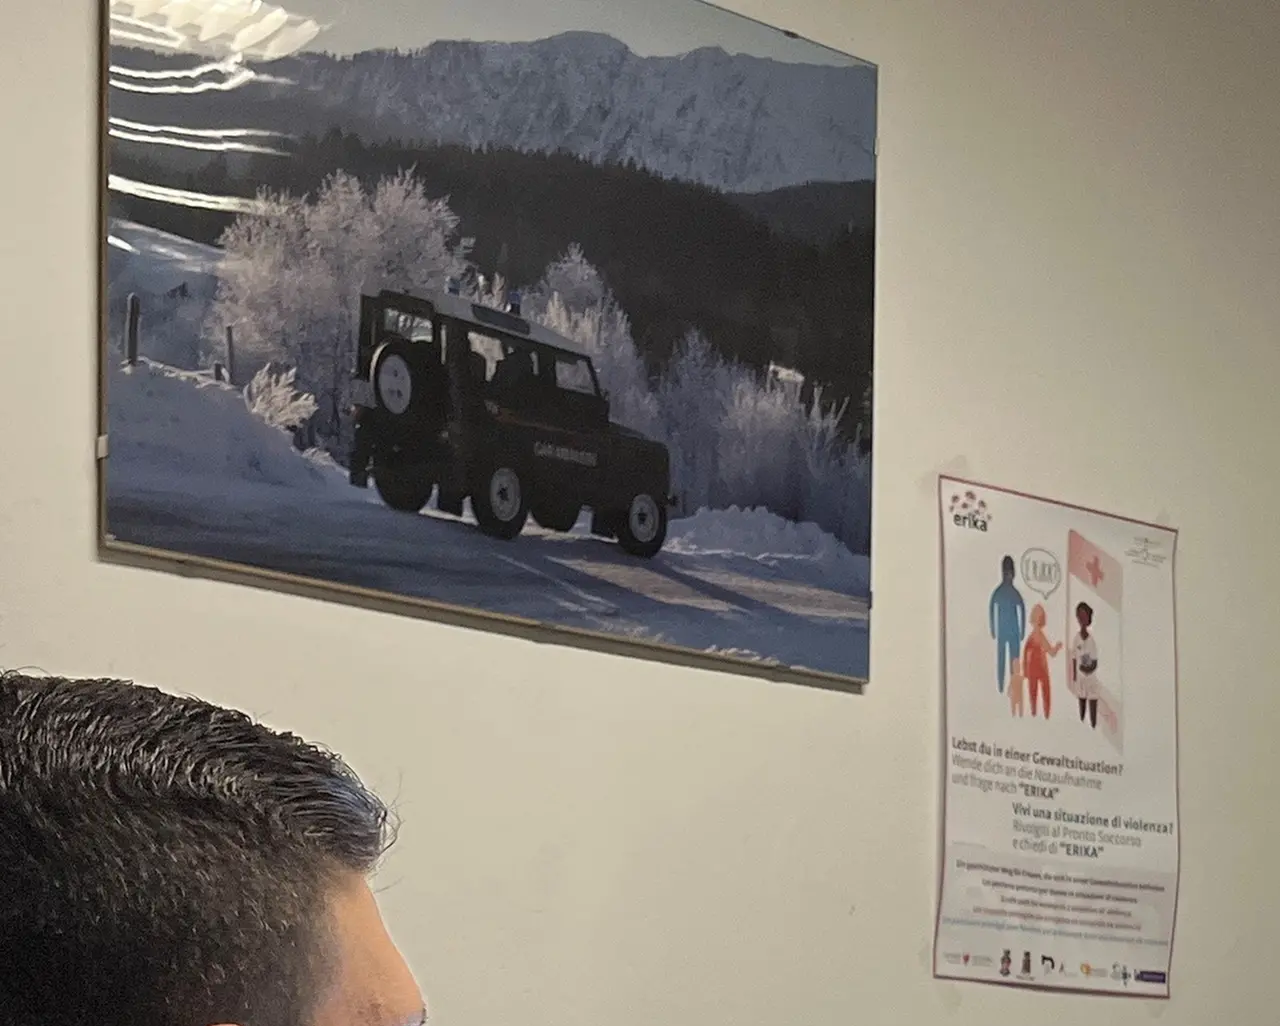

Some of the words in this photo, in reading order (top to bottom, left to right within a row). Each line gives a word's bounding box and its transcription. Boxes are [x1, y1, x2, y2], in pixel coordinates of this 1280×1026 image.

[953, 512, 988, 532] erika
[952, 736, 977, 752] Lebst
[979, 742, 991, 756] du
[993, 743, 1003, 757] in
[1005, 746, 1030, 762] einer
[1032, 752, 1124, 776] Gewaltsituation?
[1012, 802, 1031, 816] Vivi
[1033, 807, 1051, 820] una
[1054, 808, 1109, 828] situazione
[1111, 816, 1122, 829] di
[1124, 818, 1173, 835] violenza?
